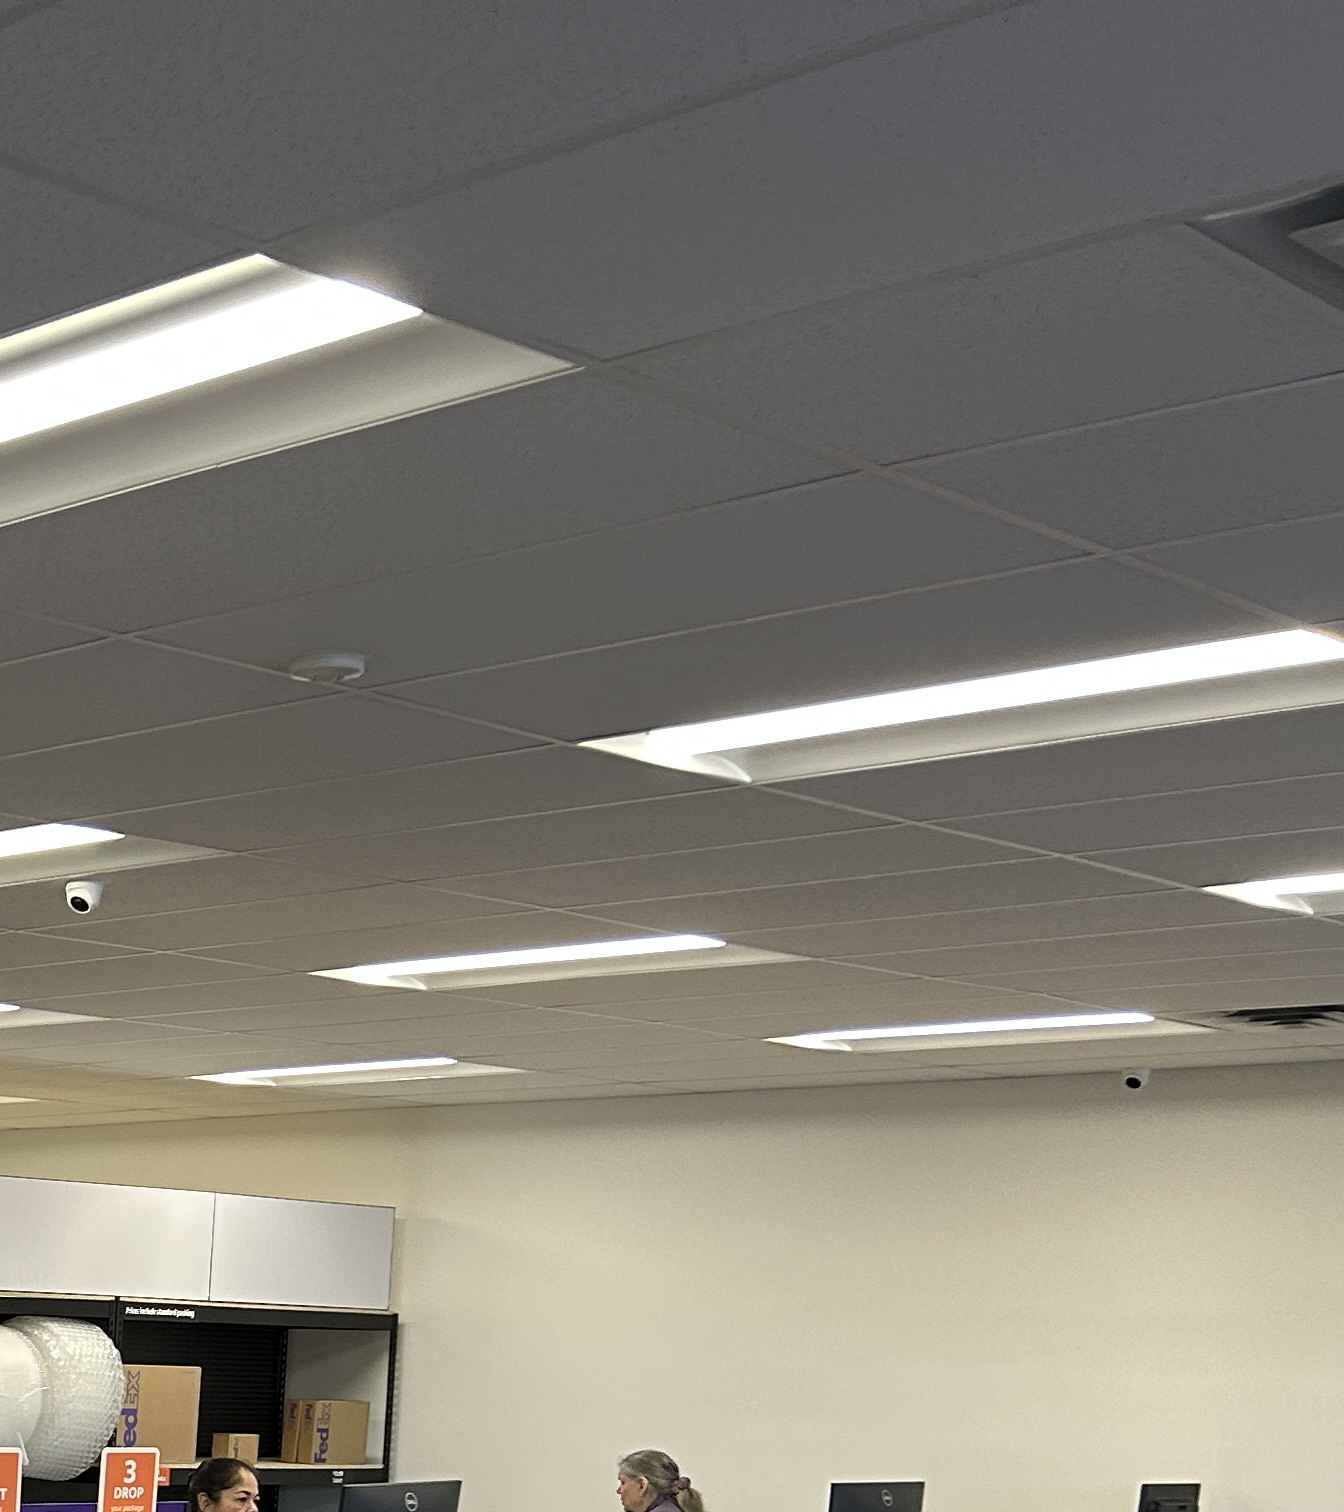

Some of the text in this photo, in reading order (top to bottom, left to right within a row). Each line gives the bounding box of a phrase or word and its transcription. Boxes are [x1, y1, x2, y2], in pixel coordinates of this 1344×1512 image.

[120, 1370, 141, 1448] edEx
[123, 1459, 138, 1484] 3
[113, 1487, 144, 1500] DROP
